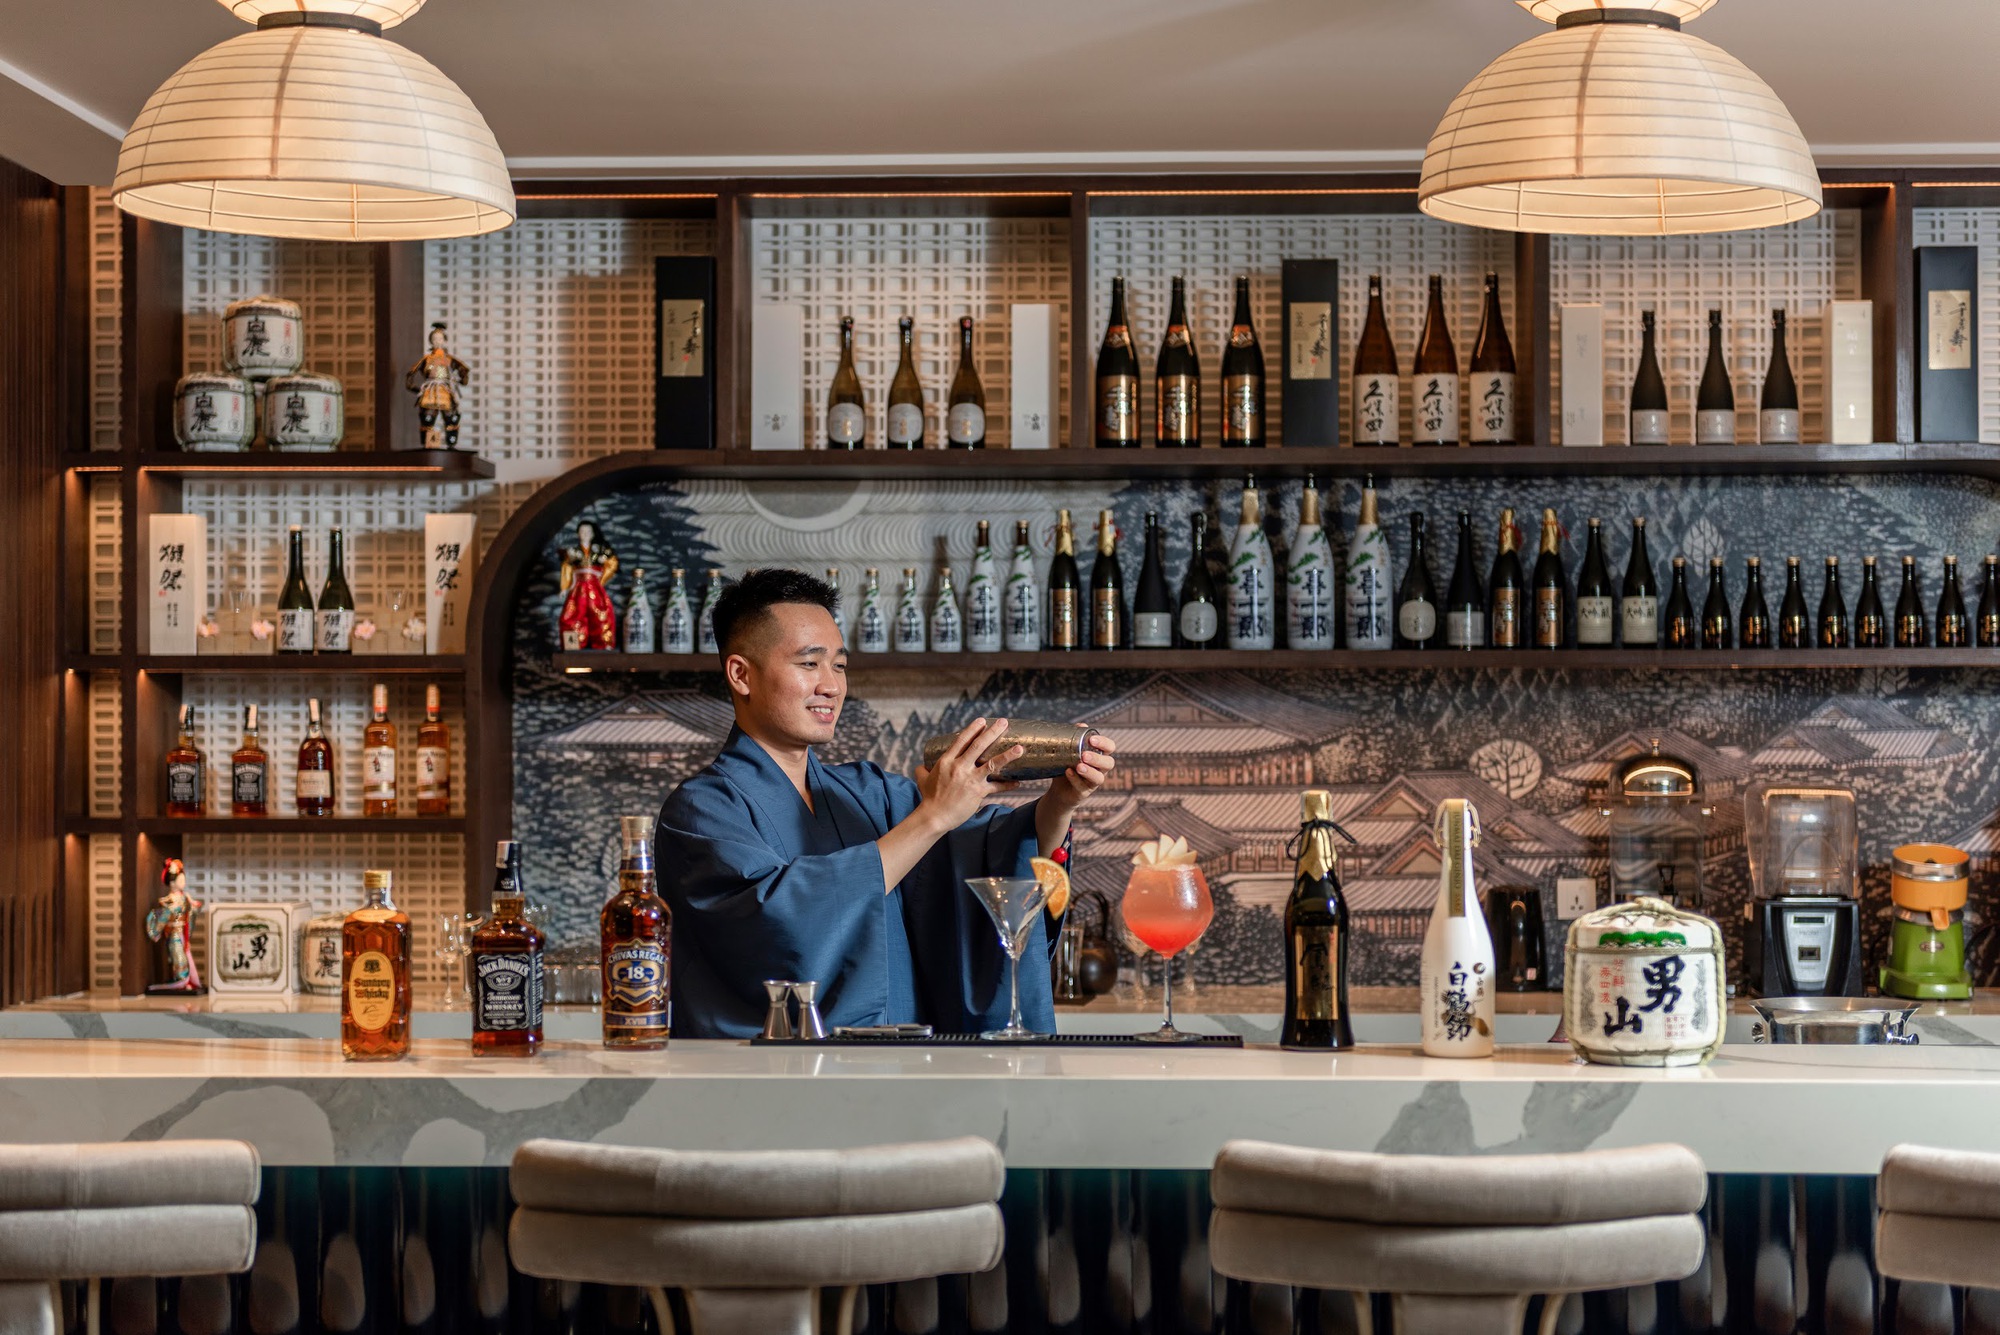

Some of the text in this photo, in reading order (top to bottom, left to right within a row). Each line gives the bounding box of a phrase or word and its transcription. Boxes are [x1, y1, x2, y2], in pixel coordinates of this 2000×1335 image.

[232, 932, 268, 971] 男山
[607, 949, 664, 964] CHIVAS REGAL
[478, 961, 498, 977] JACK
[626, 966, 645, 980] 18
[1604, 955, 1686, 1037] 男山
